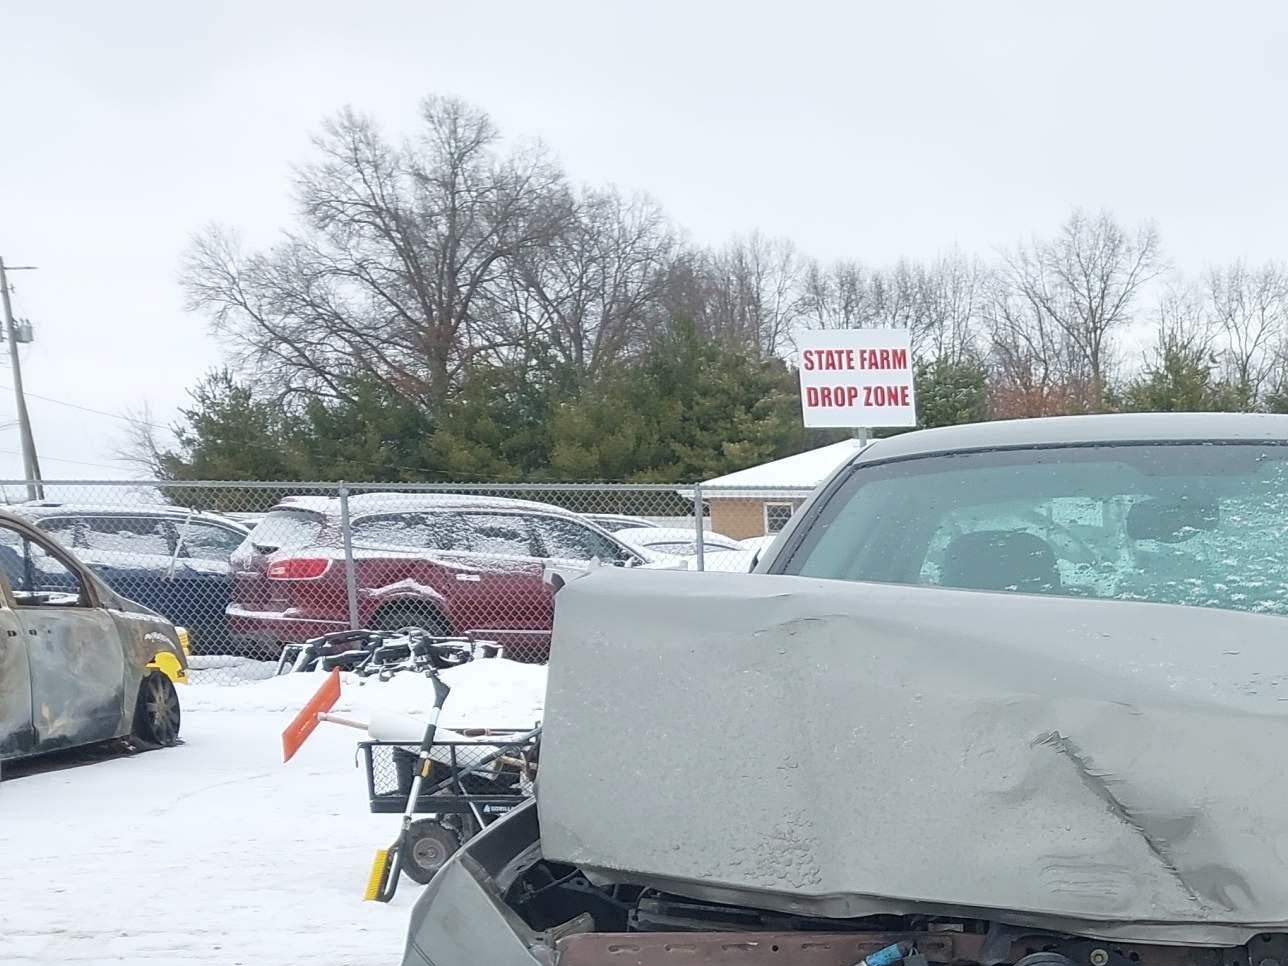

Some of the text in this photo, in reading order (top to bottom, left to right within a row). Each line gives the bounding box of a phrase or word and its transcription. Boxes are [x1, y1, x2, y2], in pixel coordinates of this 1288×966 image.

[803, 348, 908, 371] STATE FARM
[806, 385, 911, 408] DROP ZONE
